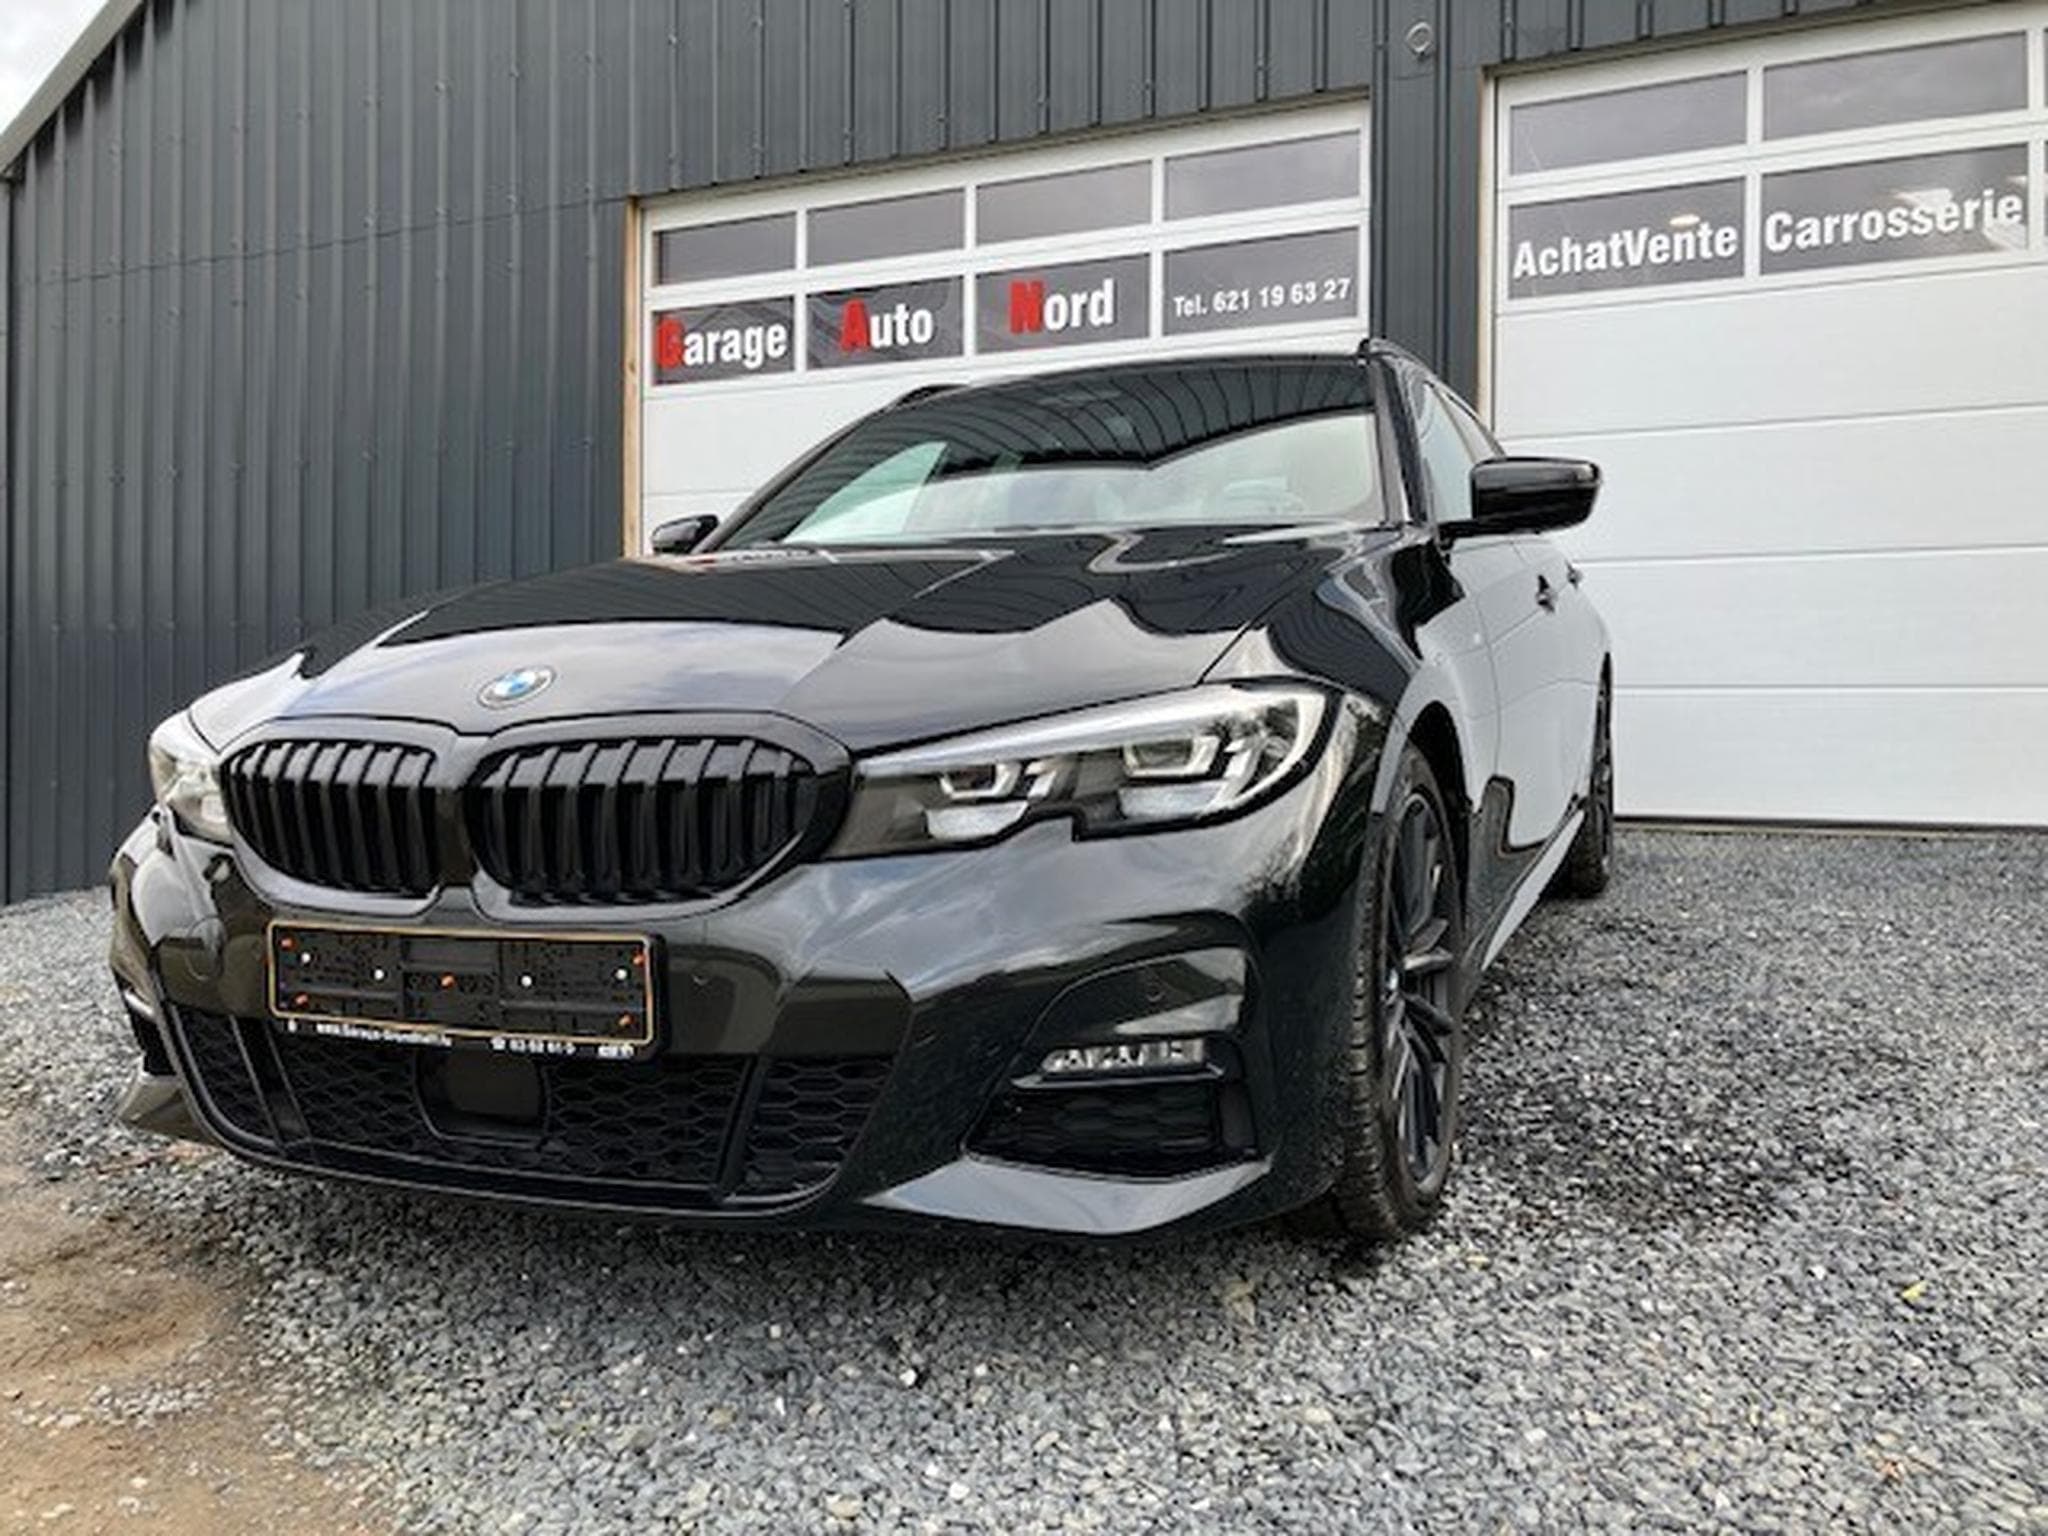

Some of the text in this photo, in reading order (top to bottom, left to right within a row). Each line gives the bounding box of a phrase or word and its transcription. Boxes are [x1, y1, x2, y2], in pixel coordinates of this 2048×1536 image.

[1765, 189, 2022, 252] Carrosserie
[656, 279, 1115, 369] Garage Auto Nord
[1173, 278, 1351, 318] Tel. 621 19 63 27
